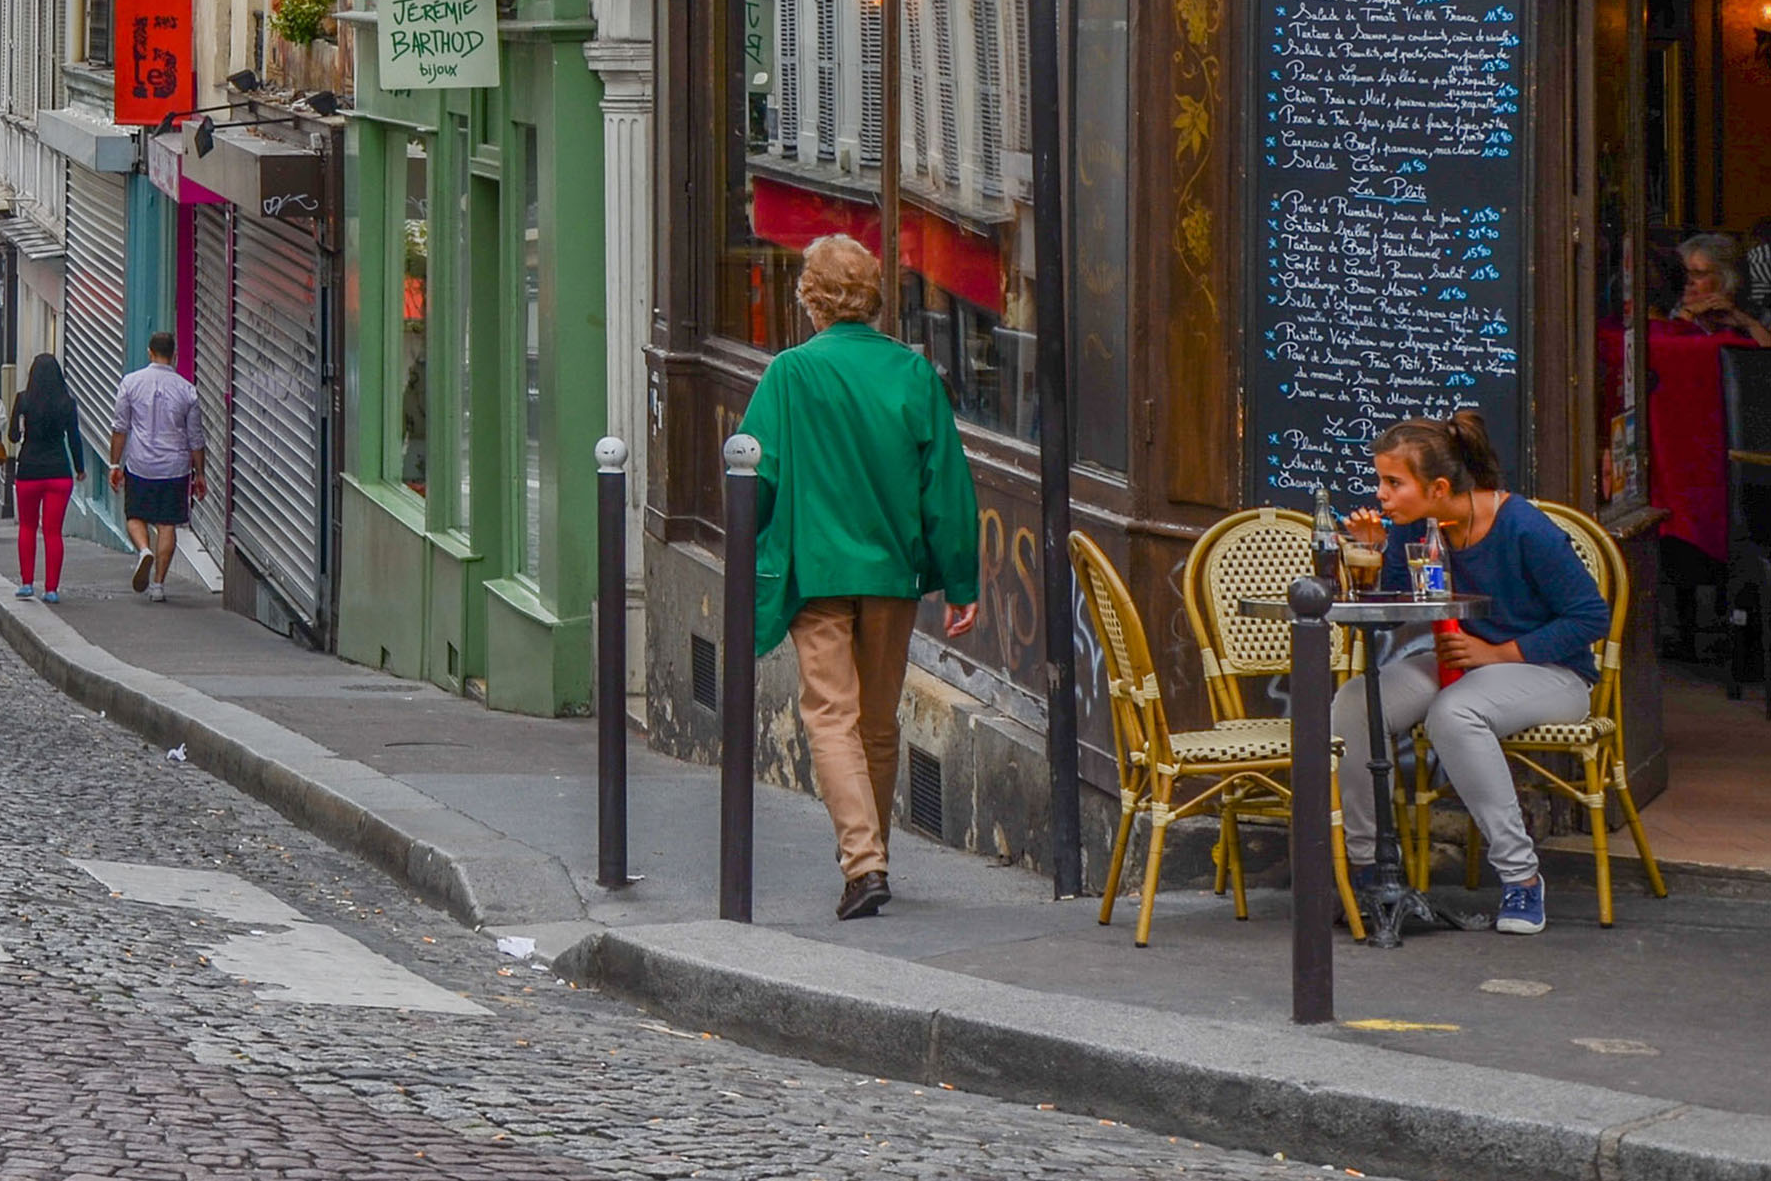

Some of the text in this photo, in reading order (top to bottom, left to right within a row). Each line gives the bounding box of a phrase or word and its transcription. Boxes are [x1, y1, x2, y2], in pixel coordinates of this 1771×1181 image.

[1292, 2, 1339, 21] Salade
[391, 30, 484, 62] BARTHOD
[420, 62, 458, 84] bijoux
[1282, 149, 1339, 171] Salade
[1348, 177, 1427, 199] Les Plats
[1323, 414, 1347, 437] Les
